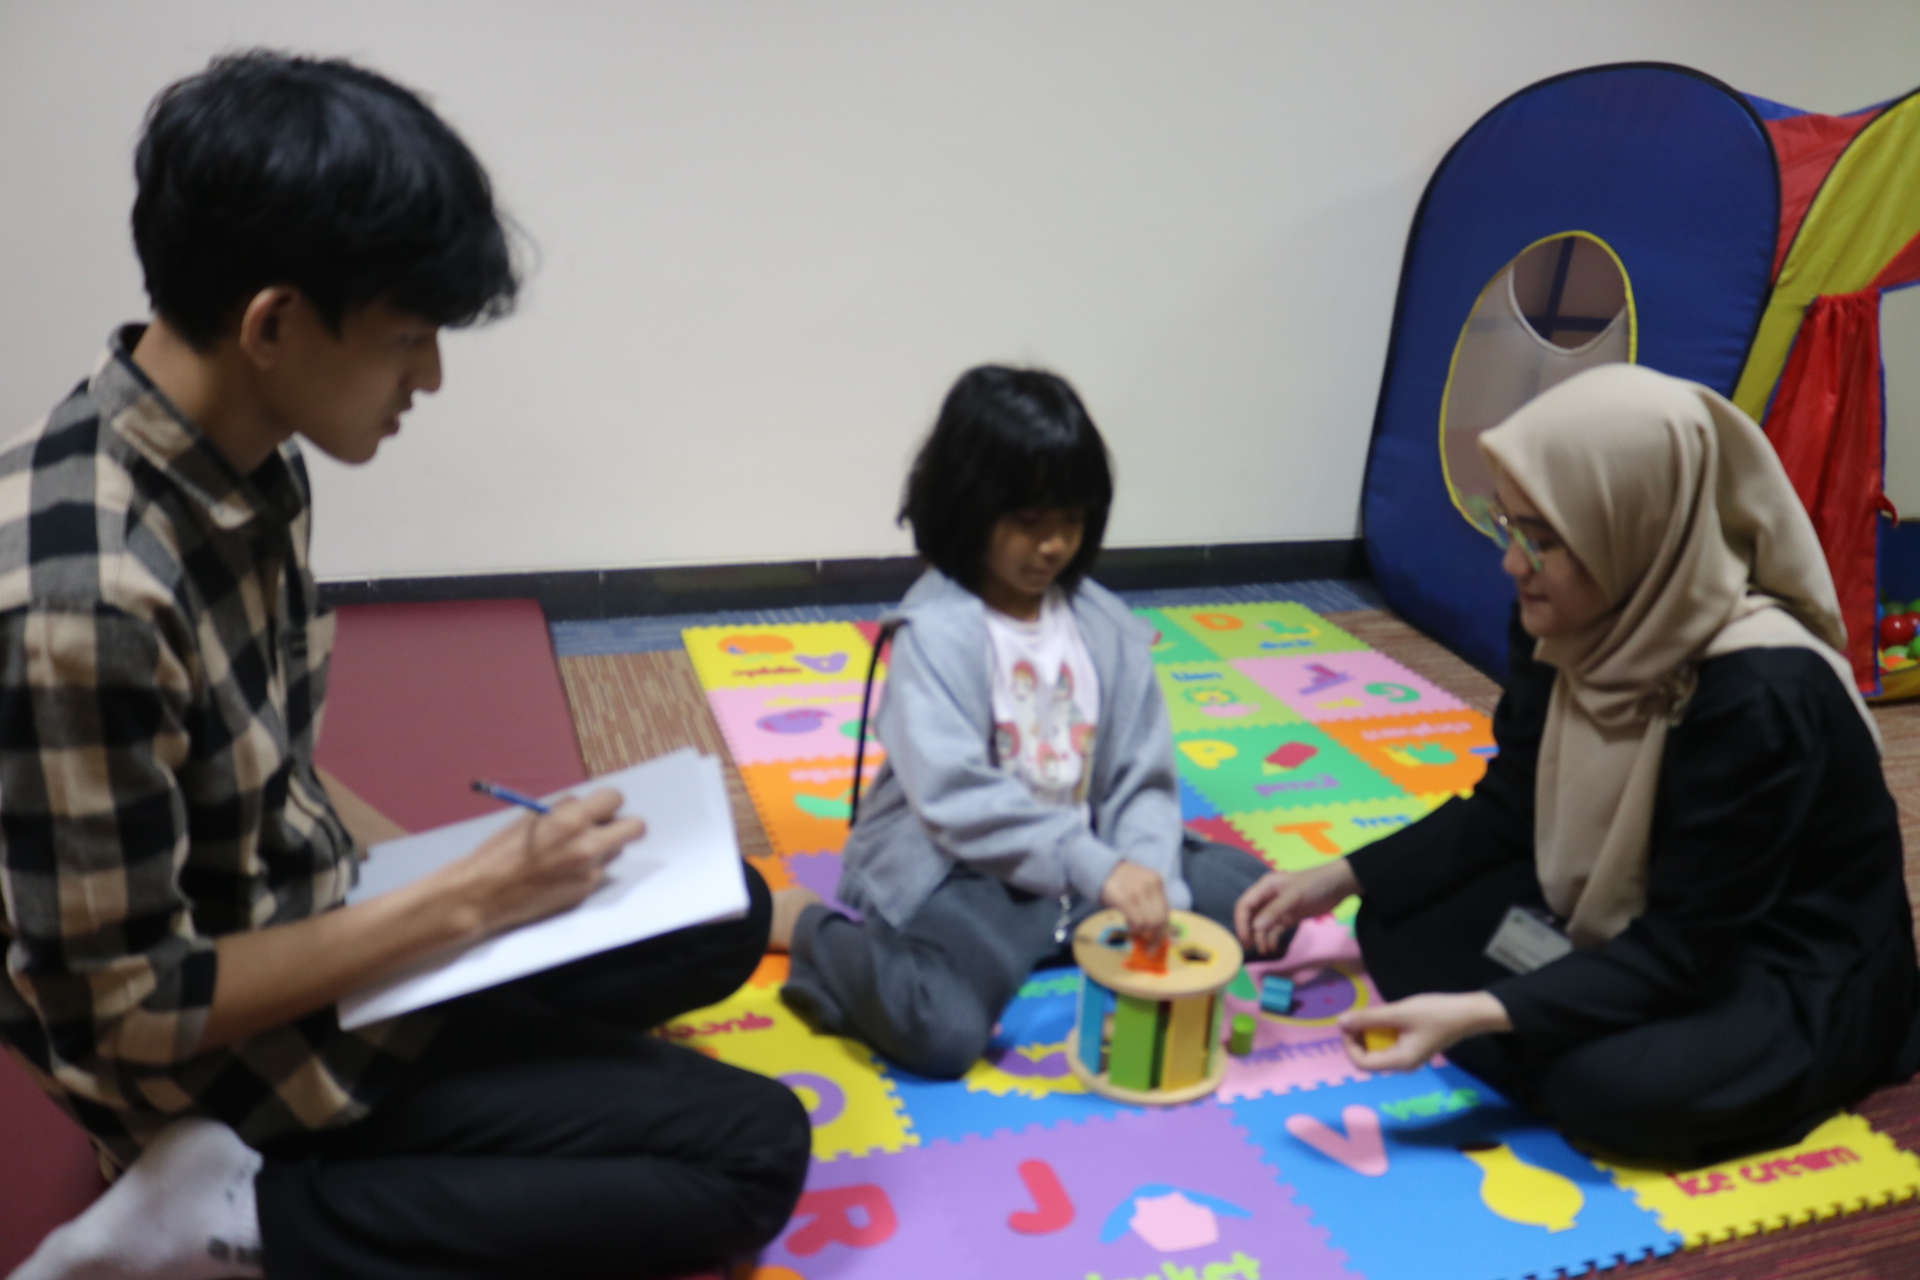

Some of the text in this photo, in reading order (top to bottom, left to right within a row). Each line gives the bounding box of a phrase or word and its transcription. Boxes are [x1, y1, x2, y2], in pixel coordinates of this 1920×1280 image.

[1273, 820, 1343, 856] T
[1285, 1104, 1390, 1178] V
[783, 1183, 899, 1257] R
